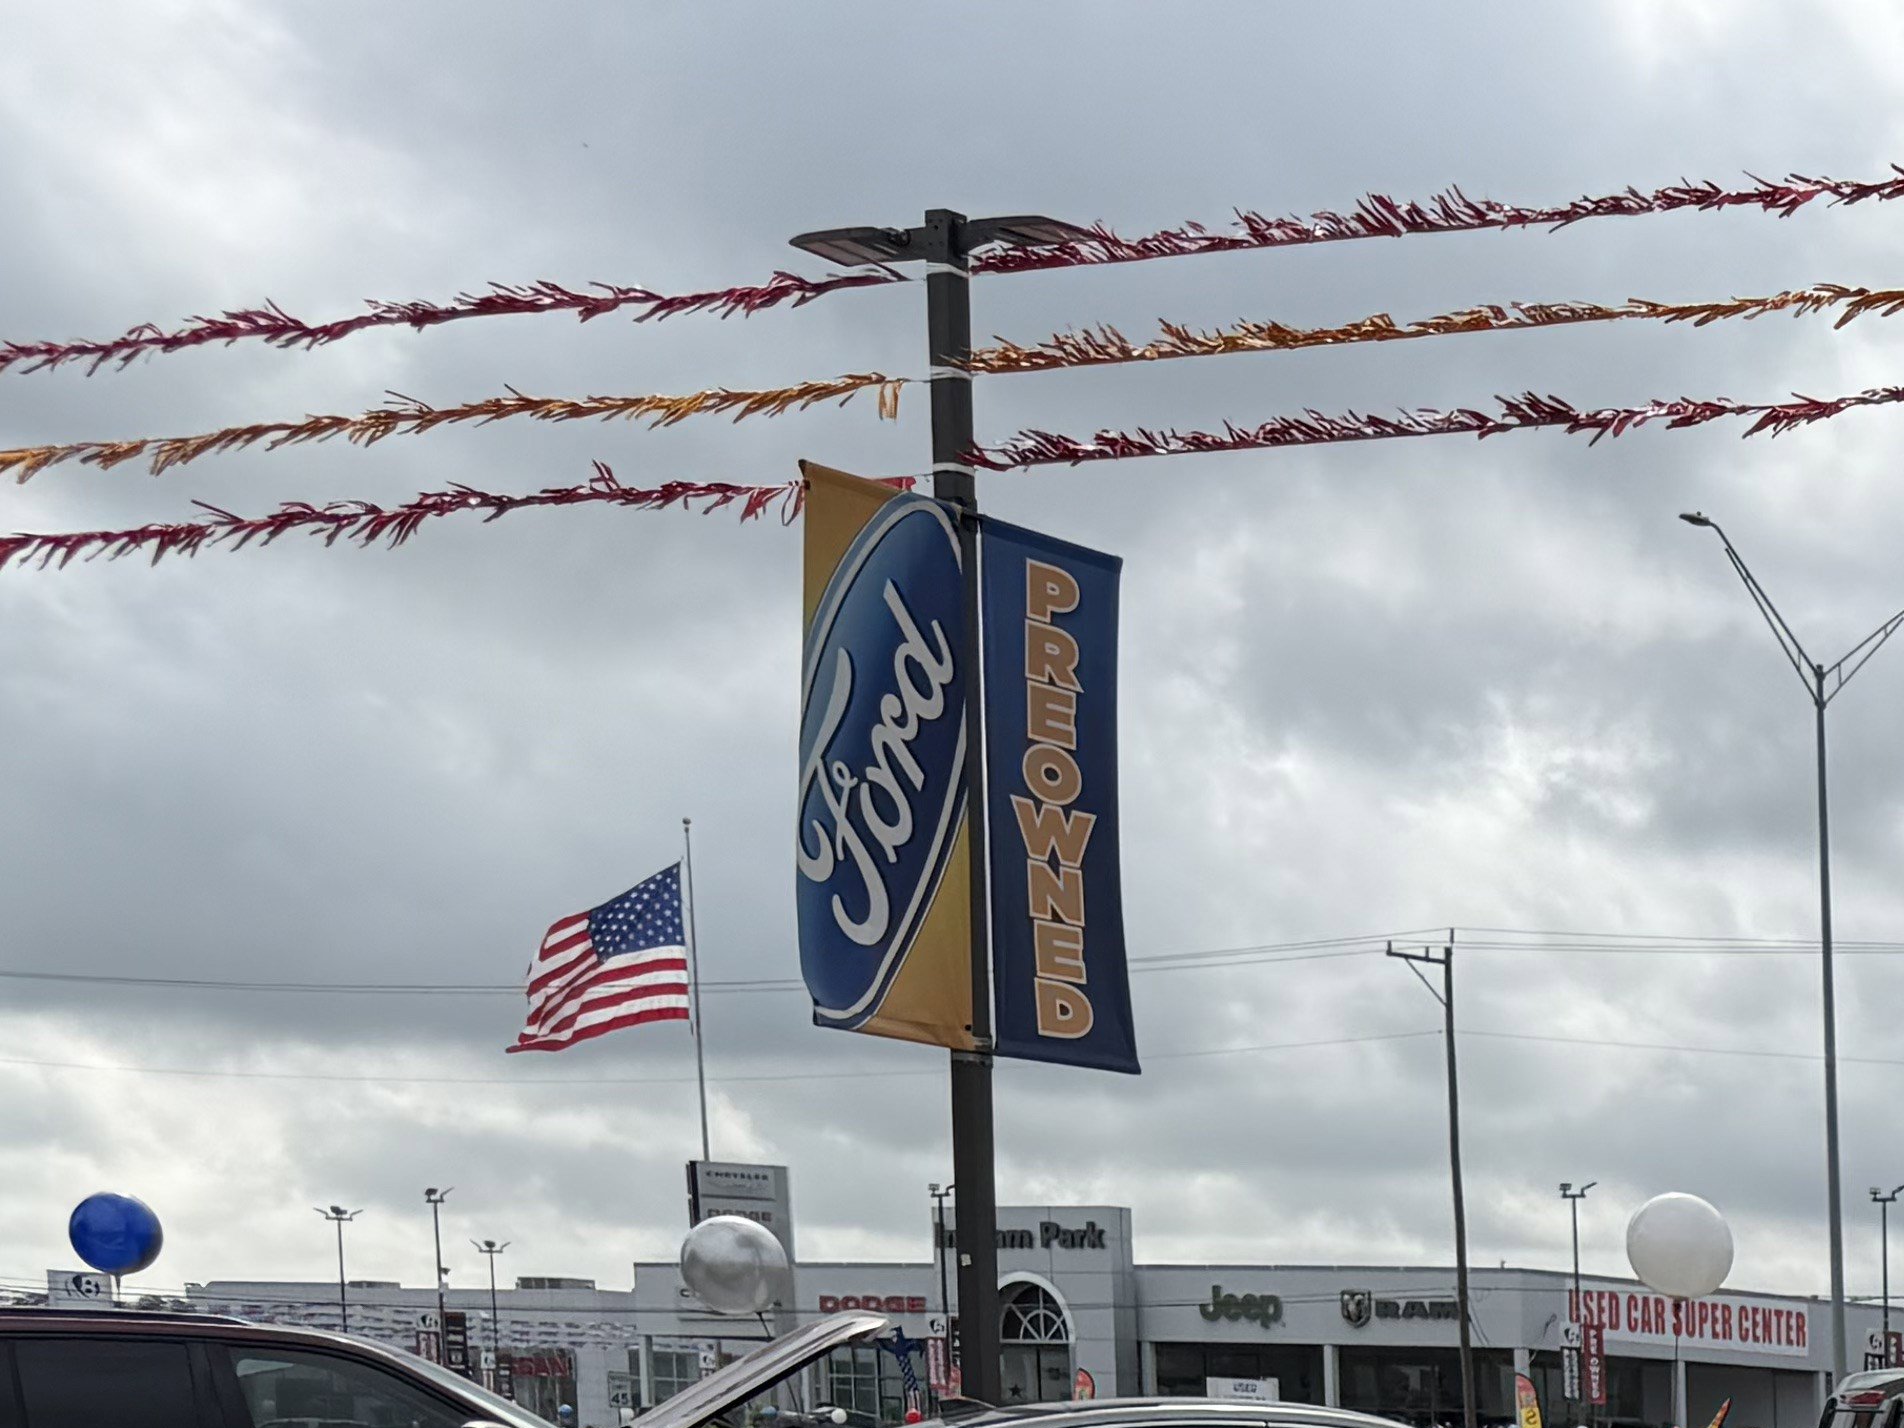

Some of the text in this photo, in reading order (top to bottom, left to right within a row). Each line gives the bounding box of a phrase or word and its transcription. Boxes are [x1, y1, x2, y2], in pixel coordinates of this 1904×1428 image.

[796, 578, 955, 946] Ford
[1010, 557, 1097, 1039] PREOWNED
[705, 1170, 769, 1181] CHRYSLER
[1039, 1221, 1106, 1249] Park
[818, 1294, 928, 1314] DODGE
[1199, 1284, 1284, 1330] Jeep
[1375, 1300, 1460, 1320] RAM
[1568, 1288, 1807, 1348] USED CAR SUPER CENTER
